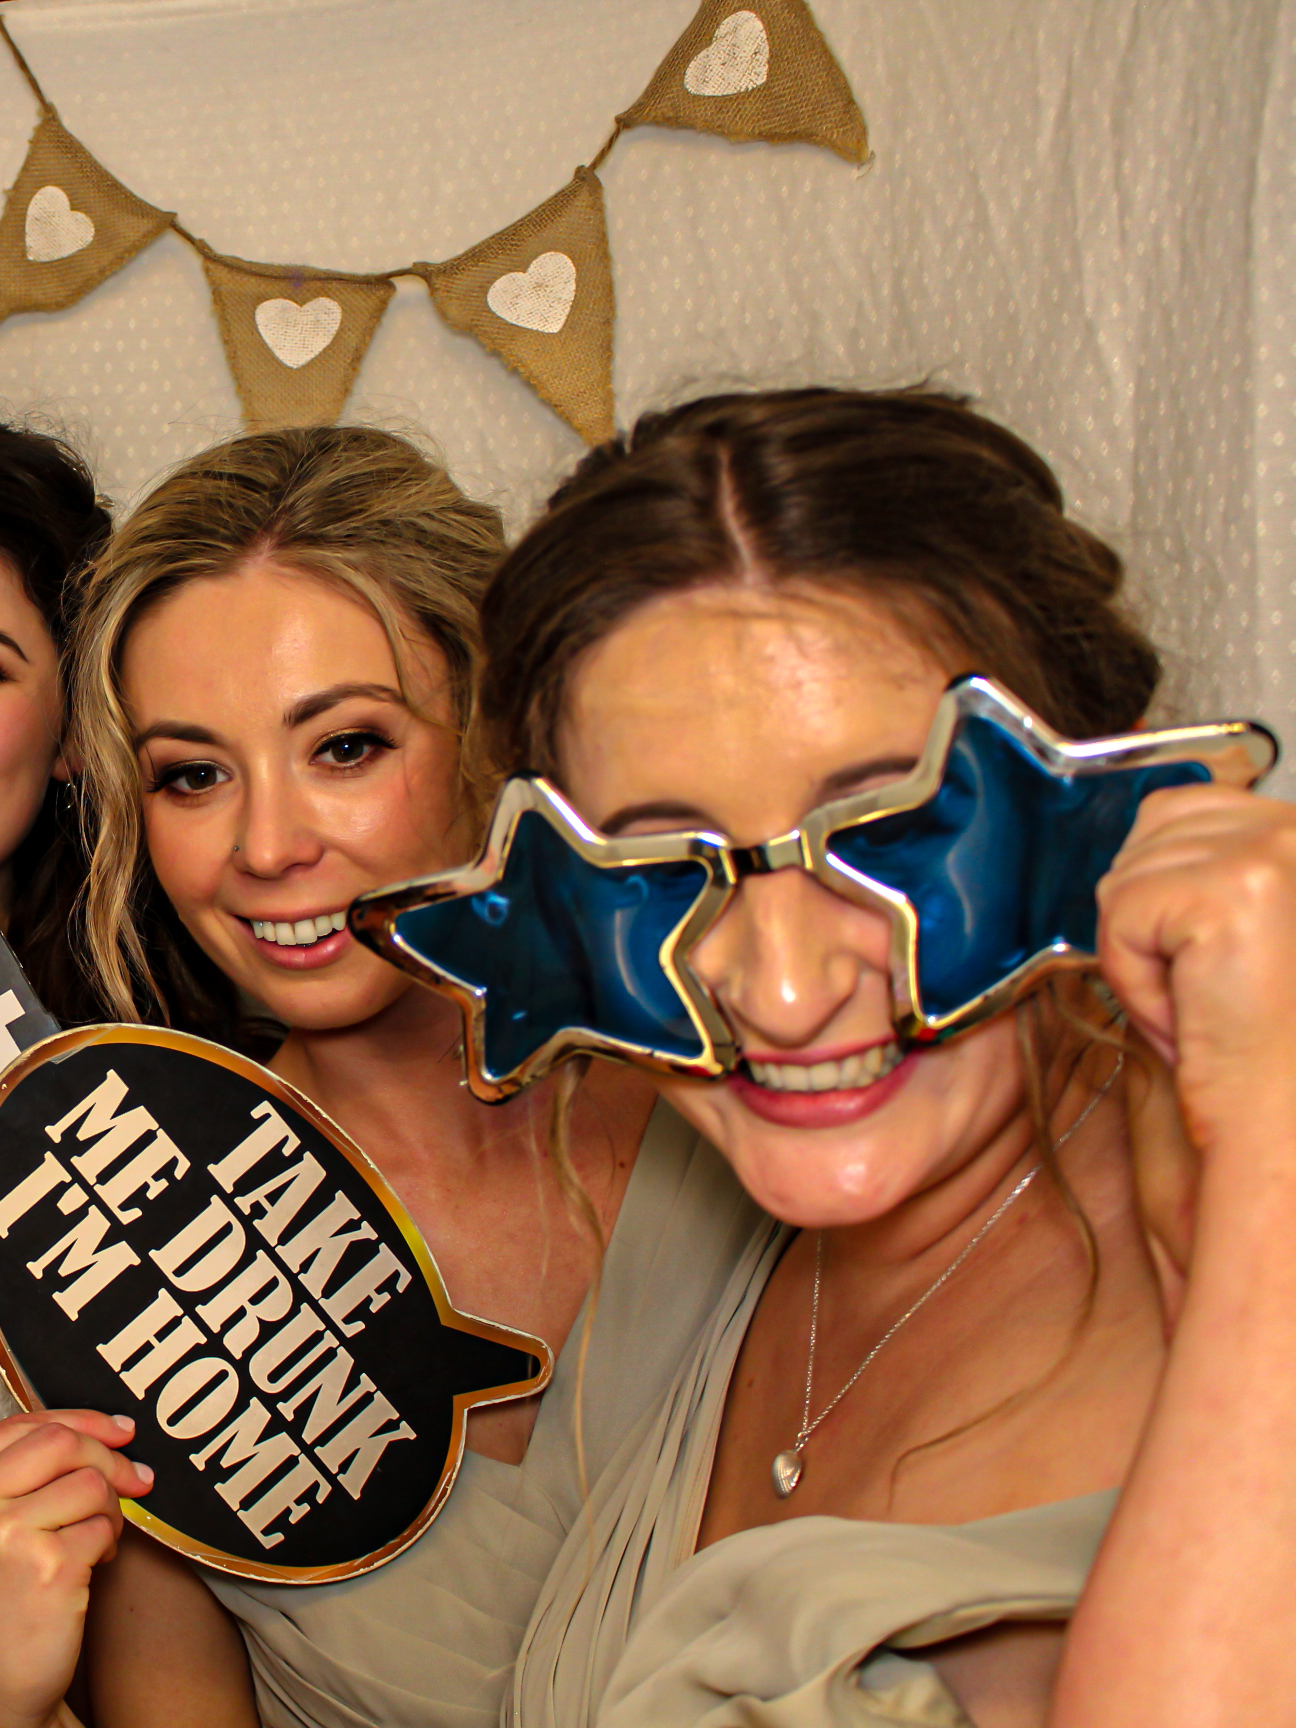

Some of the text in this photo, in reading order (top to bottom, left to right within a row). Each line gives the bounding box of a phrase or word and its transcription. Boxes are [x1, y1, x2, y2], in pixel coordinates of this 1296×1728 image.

[44, 1069, 417, 1500] ME DRUNK
[207, 1100, 412, 1338] TAKE
[96, 1288, 332, 1550] HOME
